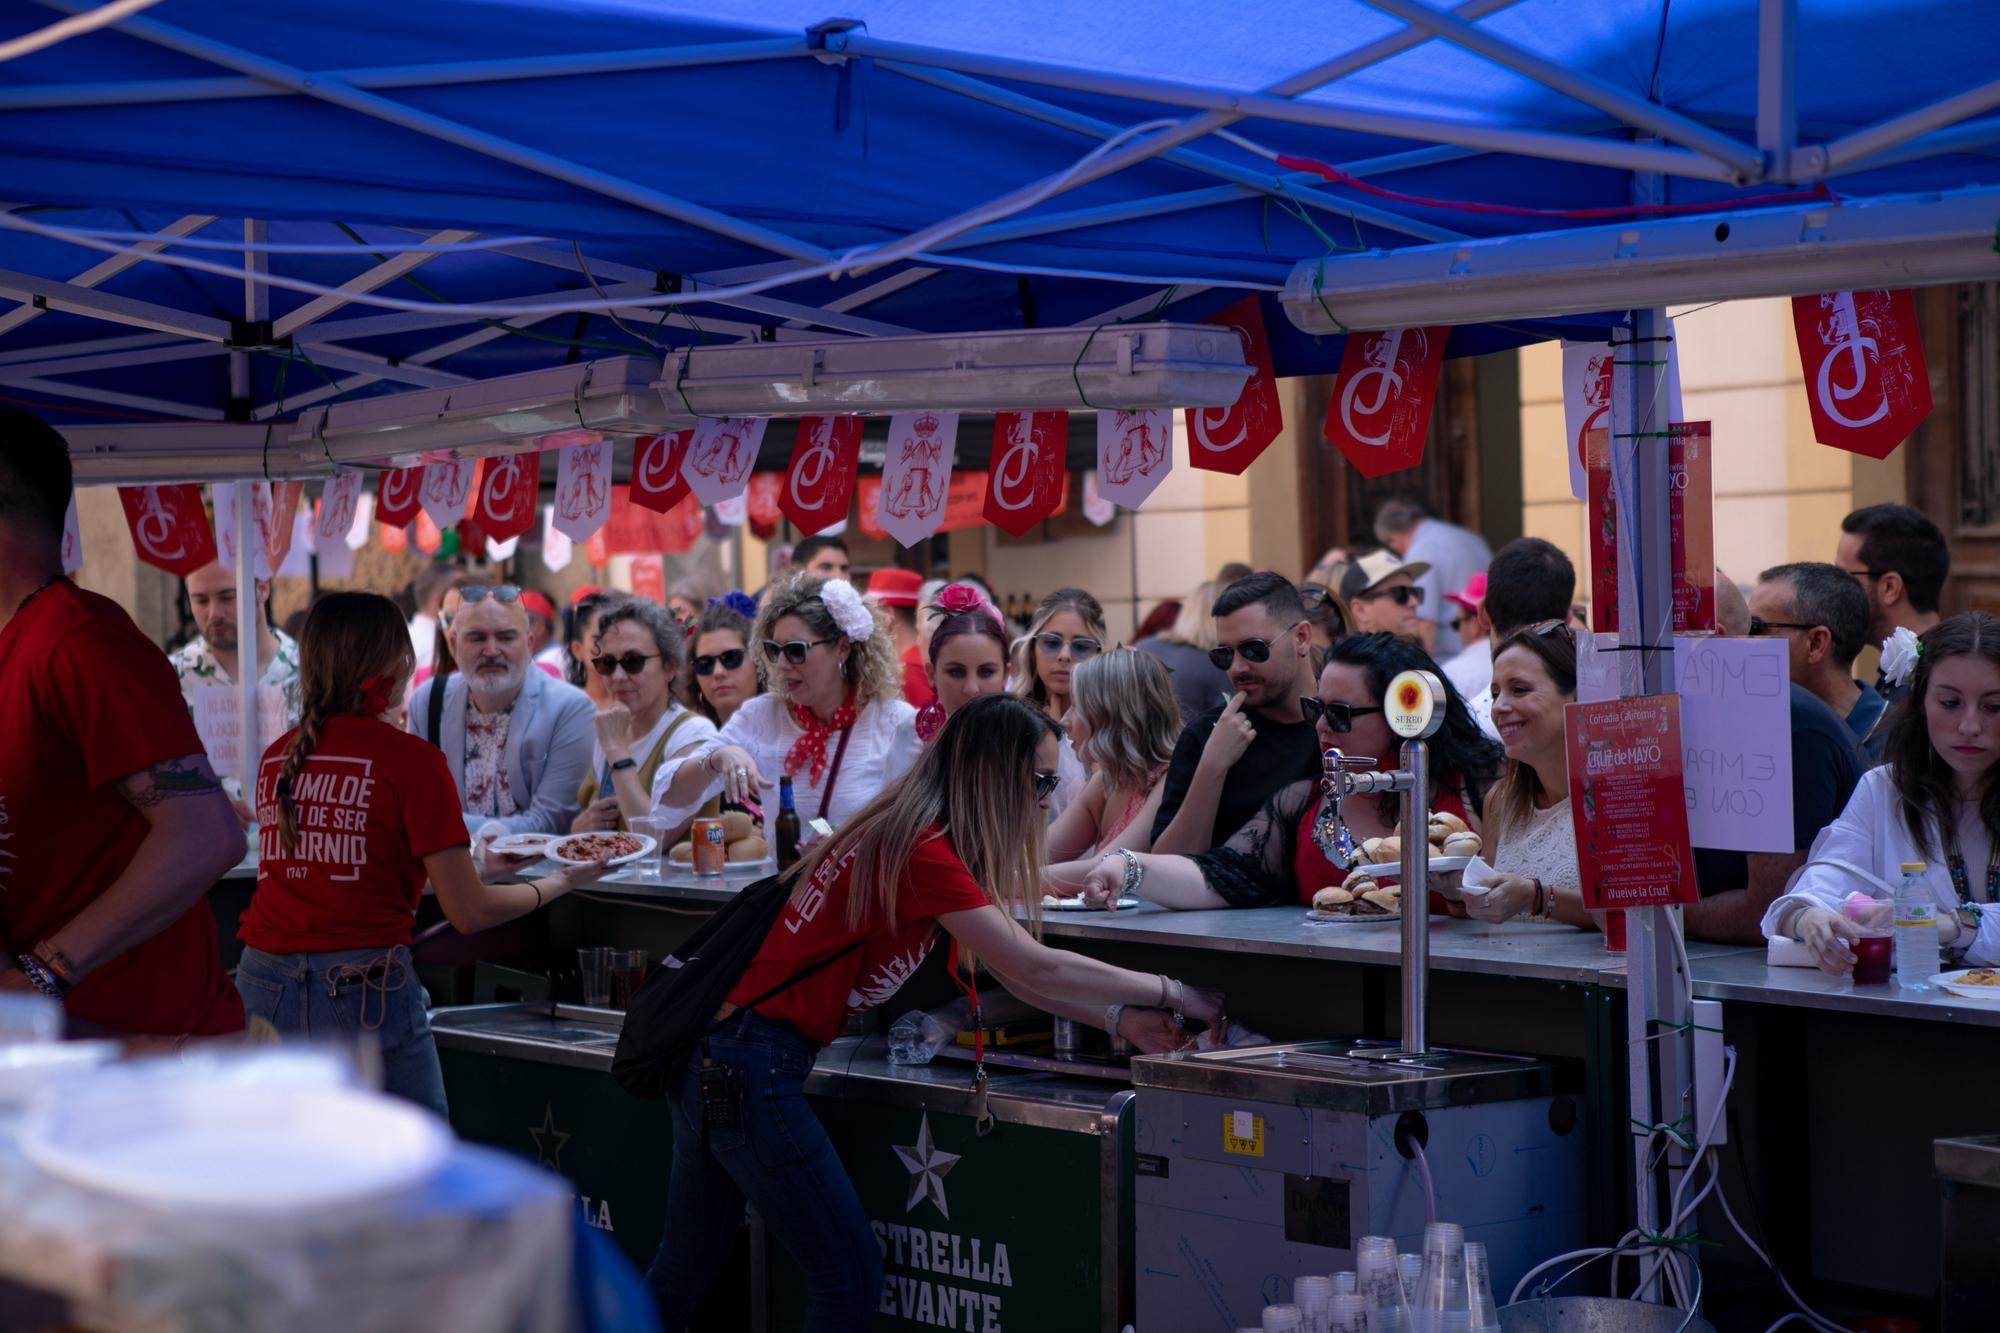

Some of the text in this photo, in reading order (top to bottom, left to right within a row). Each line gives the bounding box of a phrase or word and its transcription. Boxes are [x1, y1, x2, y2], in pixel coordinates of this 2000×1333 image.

[1669, 472, 1689, 489] YO
[1614, 750, 1627, 766] de
[1628, 745, 1661, 764] MAYO
[272, 773, 375, 809] UMILDE
[307, 805, 329, 828] DE
[333, 807, 368, 832] SER
[286, 866, 308, 879] 1747
[870, 1219, 1013, 1287] STRELLA
[877, 1273, 1002, 1333] EVANTE
